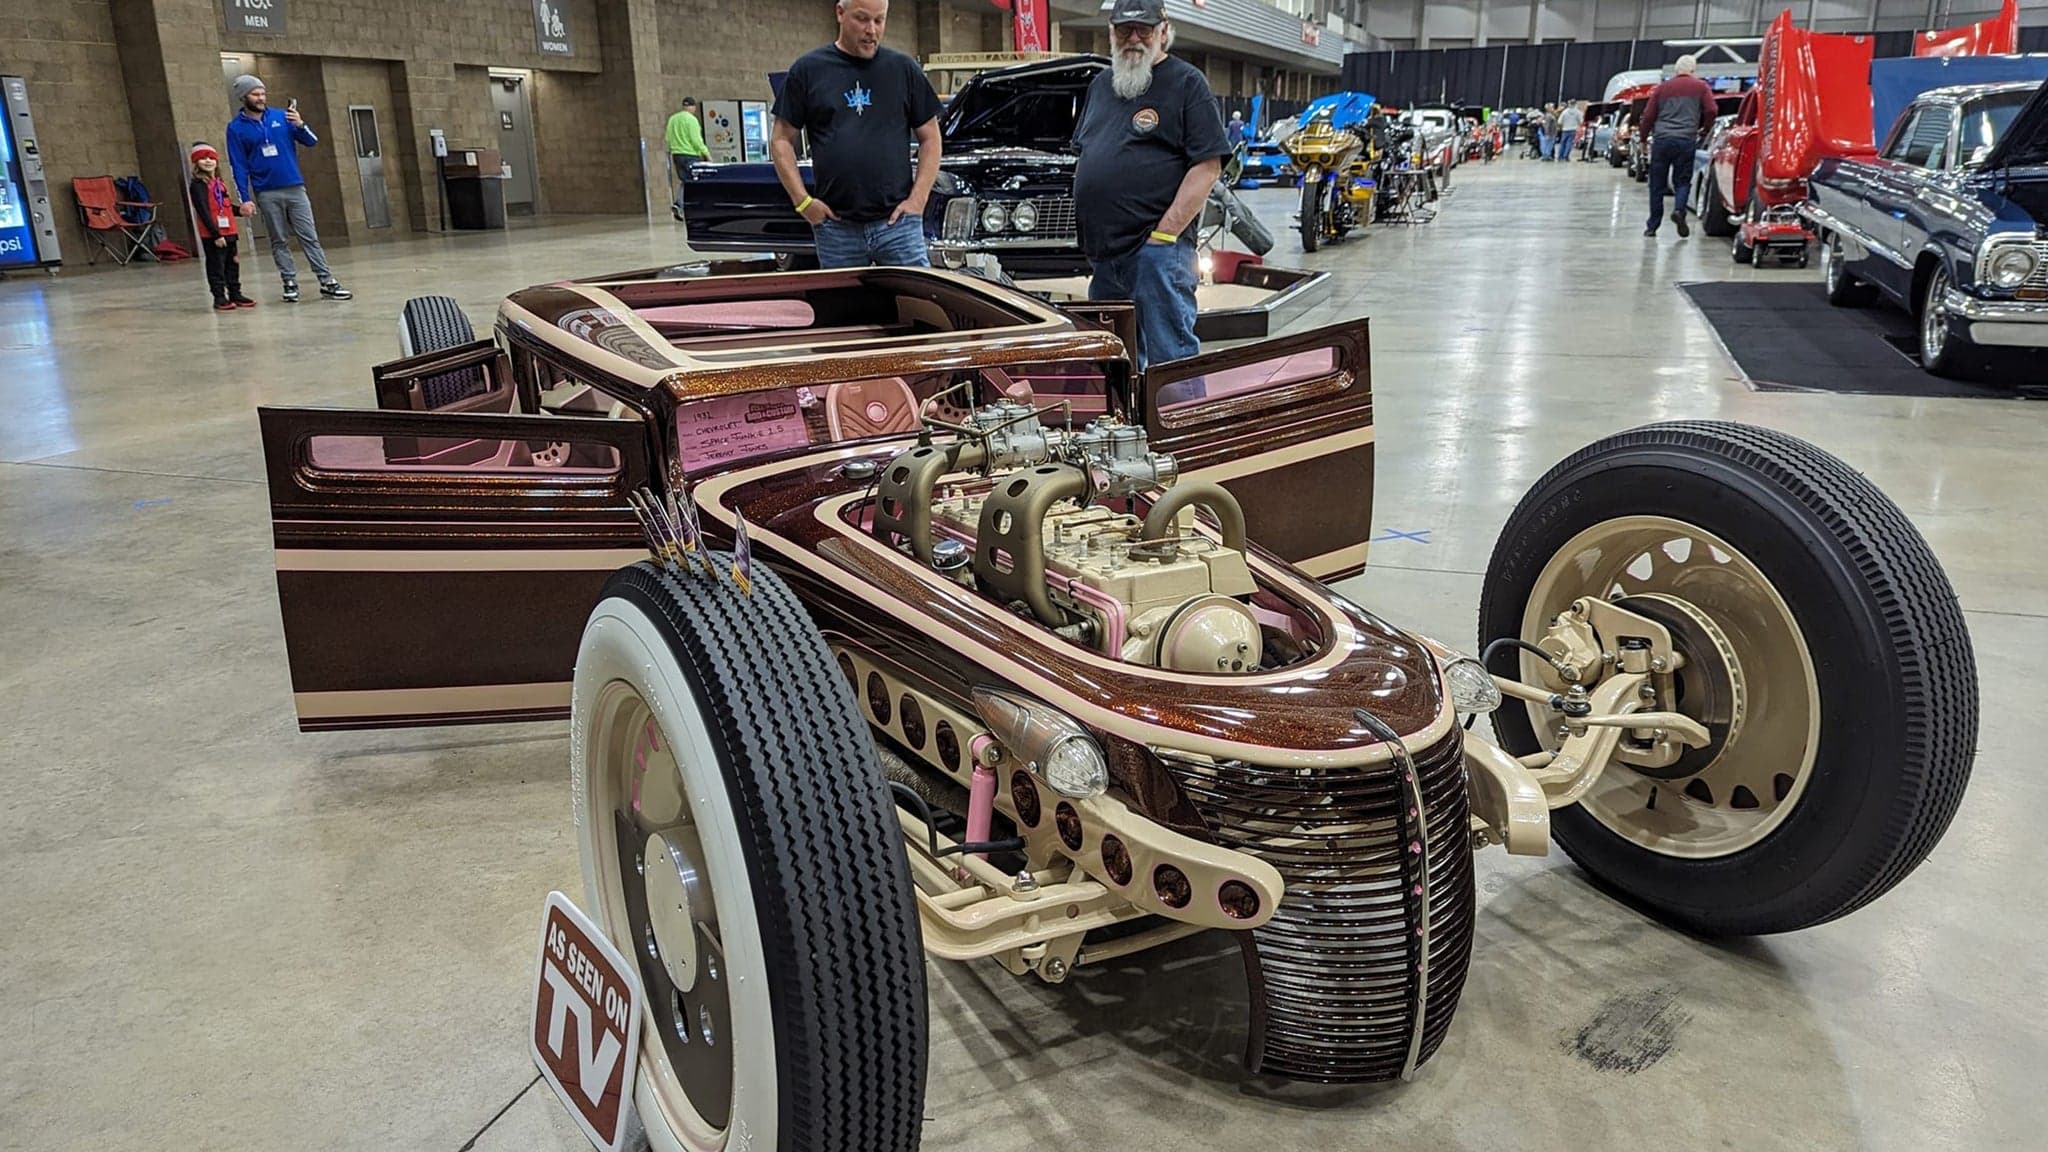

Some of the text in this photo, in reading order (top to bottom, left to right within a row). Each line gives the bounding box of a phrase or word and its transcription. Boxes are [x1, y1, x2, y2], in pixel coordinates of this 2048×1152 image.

[244, 15, 268, 28] MEN
[542, 41, 568, 51] WOMEN
[696, 421, 742, 436] CHEVROLET
[547, 921, 628, 1034] AS SEEN ON
[544, 957, 622, 1109] TV
